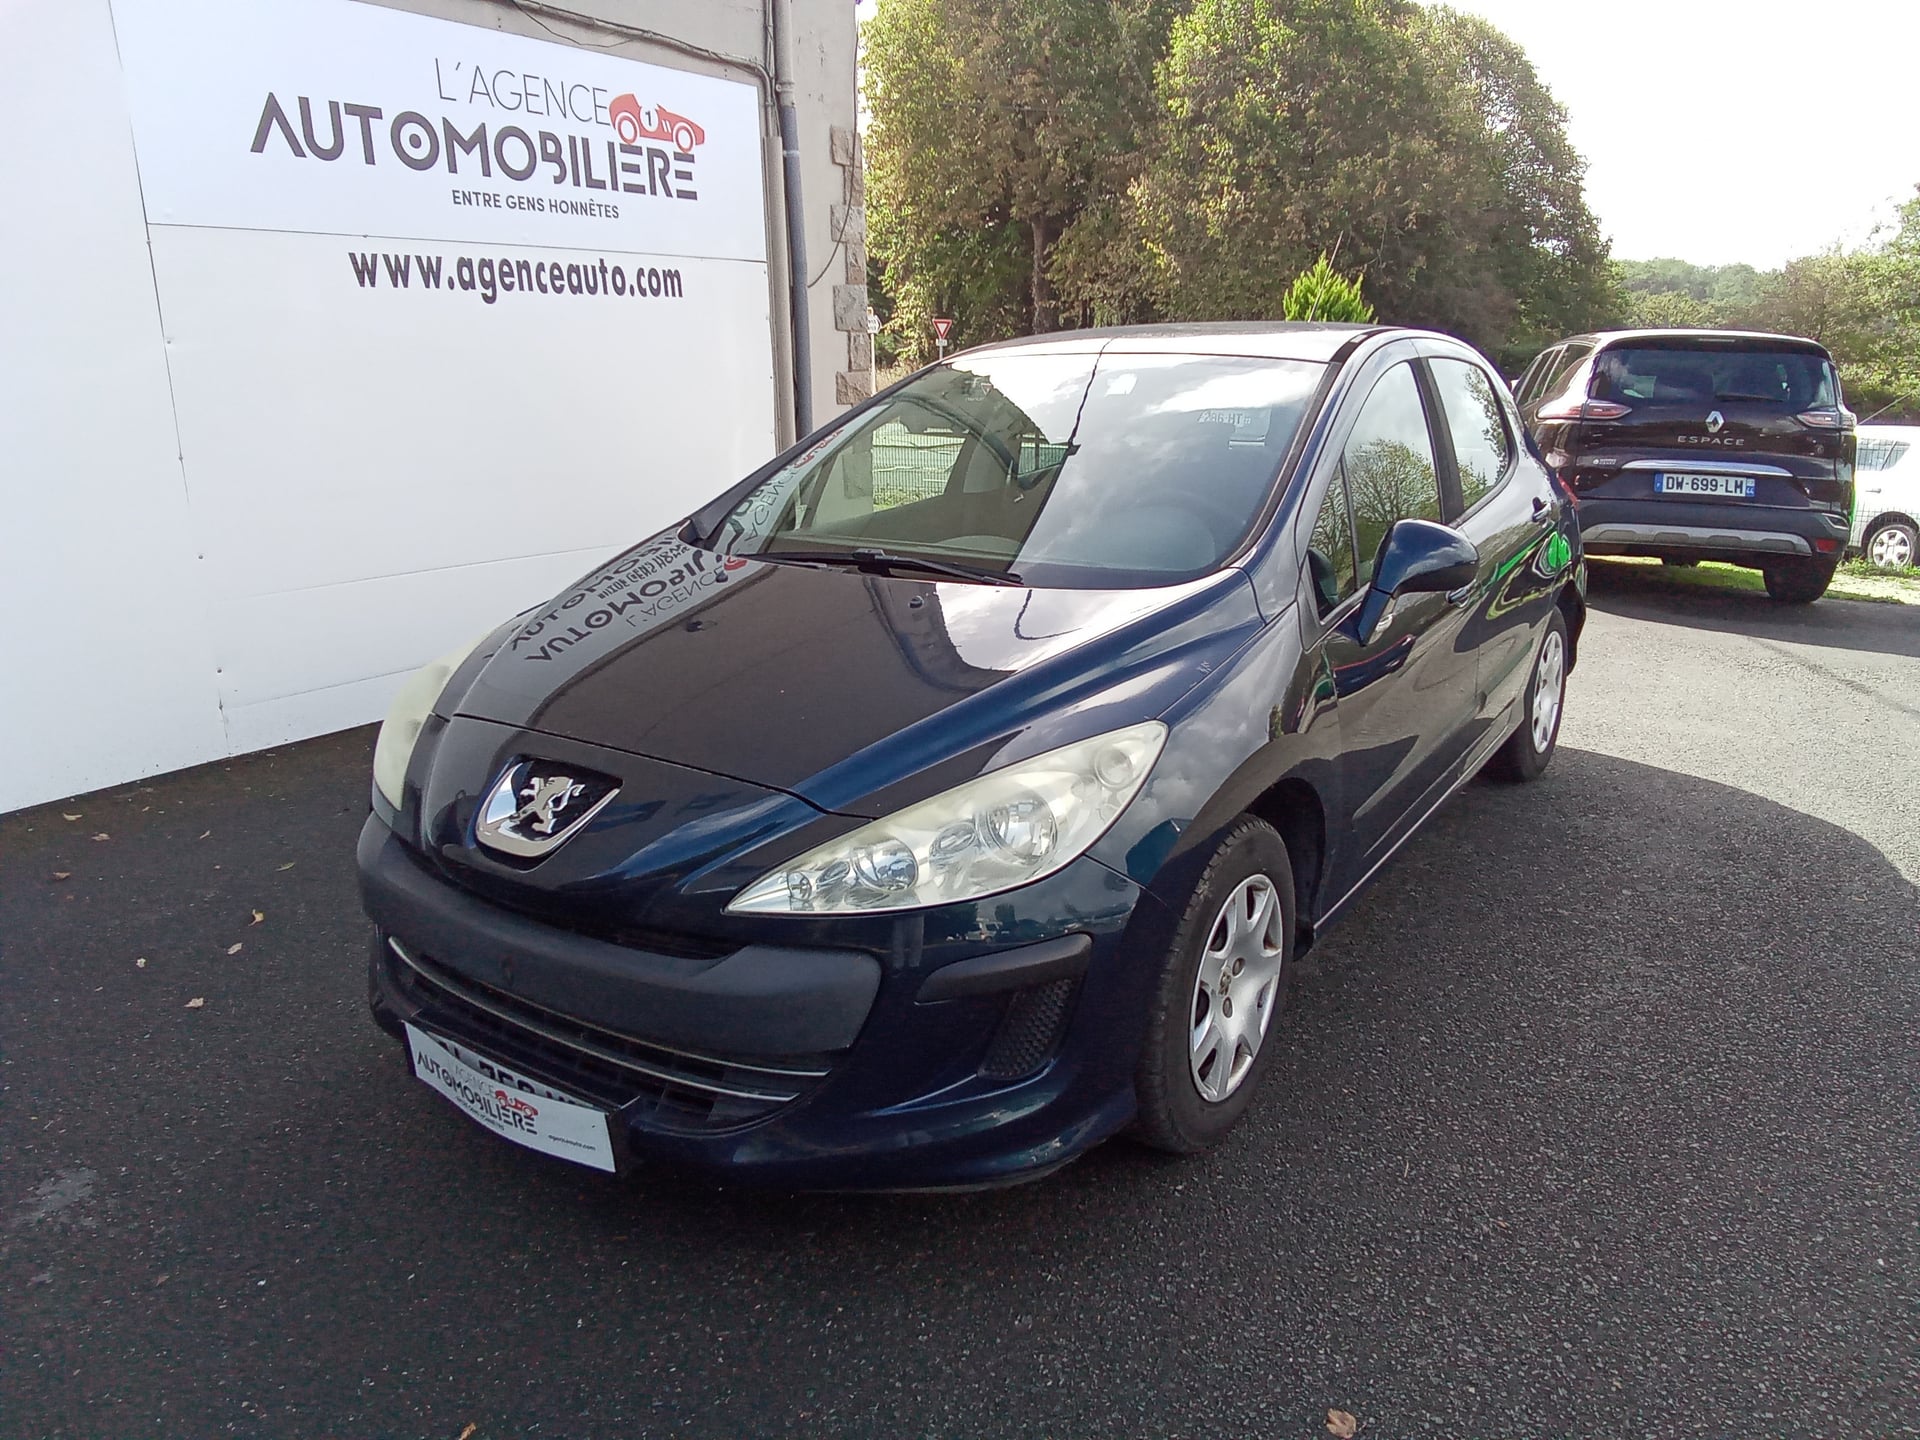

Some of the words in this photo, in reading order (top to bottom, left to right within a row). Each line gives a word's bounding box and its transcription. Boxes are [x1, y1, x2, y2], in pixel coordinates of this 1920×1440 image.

[434, 57, 610, 127] L'AGENCE
[250, 91, 698, 200] AUTOMOBILIERE
[451, 188, 502, 209] ENTRE
[505, 194, 546, 213] GENS
[548, 196, 620, 219] HONNÊTES
[348, 251, 684, 304] www.agenceauto.com
[1677, 435, 1745, 446] ESPACE
[1665, 475, 1744, 494] DW-699-LM
